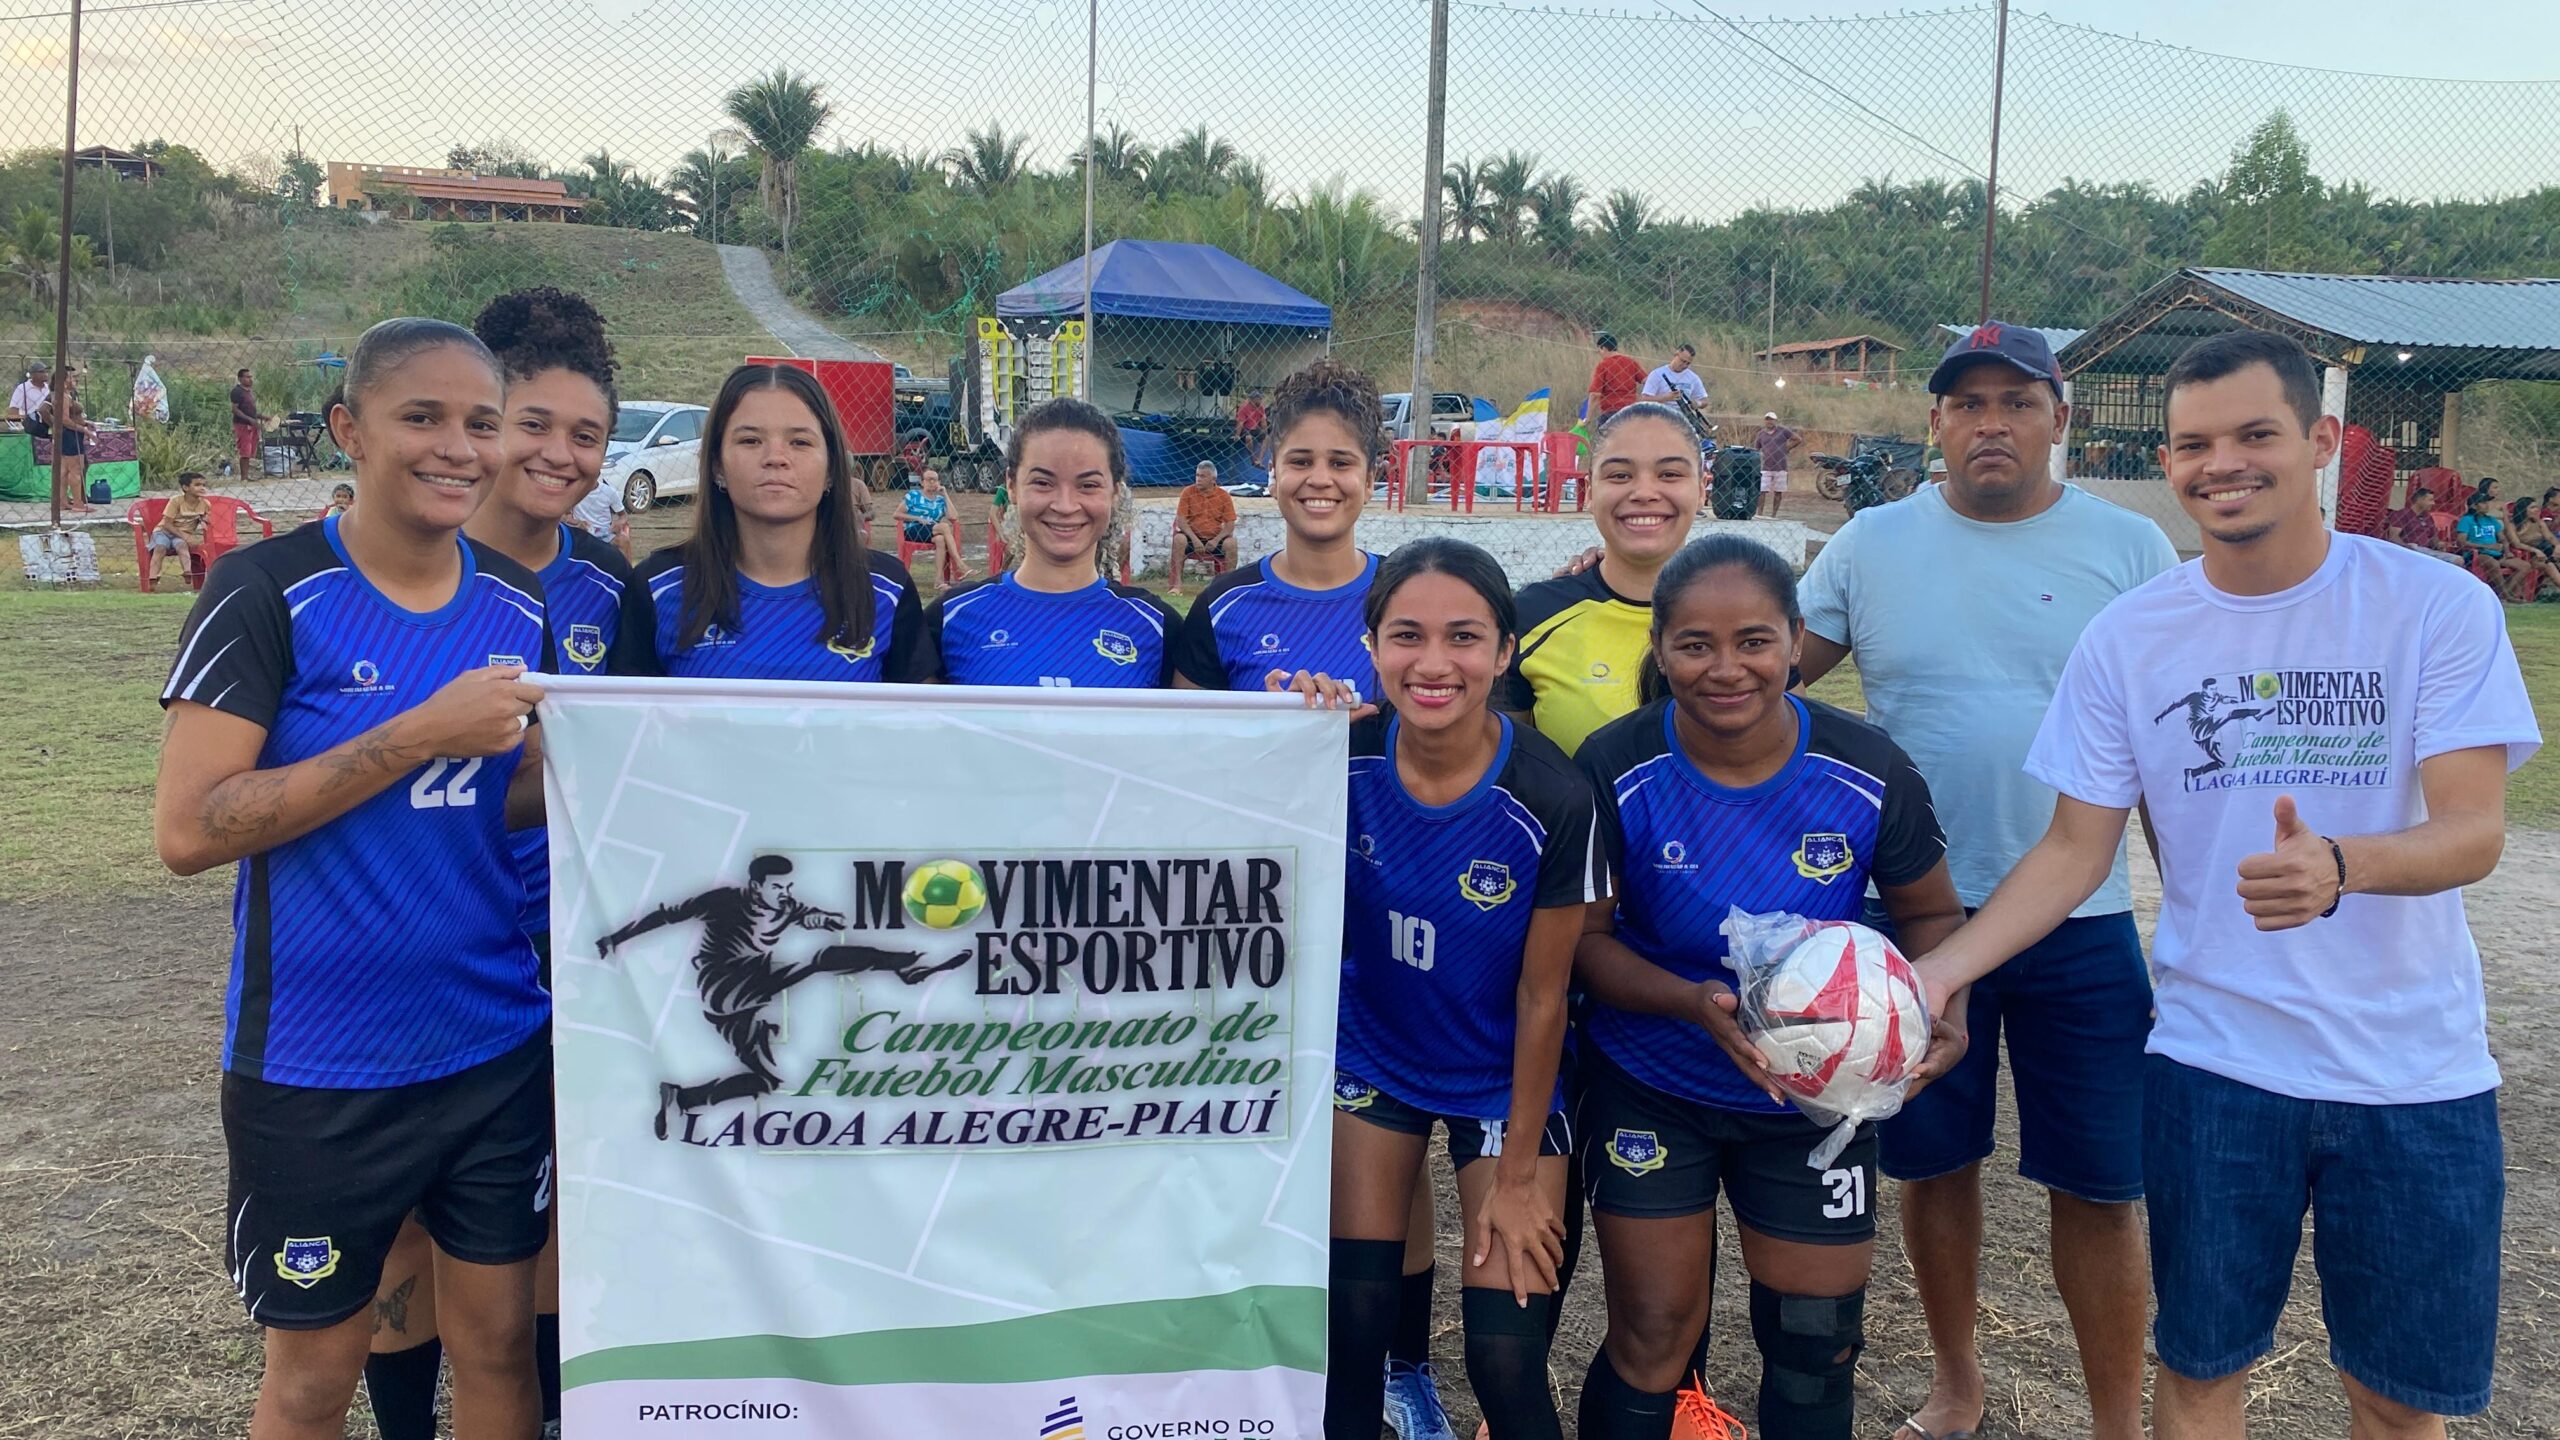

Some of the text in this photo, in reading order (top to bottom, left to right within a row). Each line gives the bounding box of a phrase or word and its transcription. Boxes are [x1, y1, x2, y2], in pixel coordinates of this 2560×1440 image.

[2276, 699, 2386, 726] ESPORTIVO
[2231, 749, 2389, 769] Futebol Masculino
[2242, 730, 2386, 756] Campeonato de
[410, 757, 482, 810] 22
[2249, 766, 2390, 787] ALEGRE-PIAUÍ
[975, 926, 1285, 995] ESPORTIVO
[1388, 910, 1436, 972] 10
[841, 1002, 1281, 1066] Campeonato de
[792, 1047, 1283, 1098] Futebol Masculino
[679, 1090, 1284, 1148] LAGOA ALEGRE-PIAUÍ
[1821, 1165, 1866, 1219] 31
[639, 1399, 798, 1421] PATROCÍNIO:
[1107, 1418, 1275, 1440] GOVERNO DO
